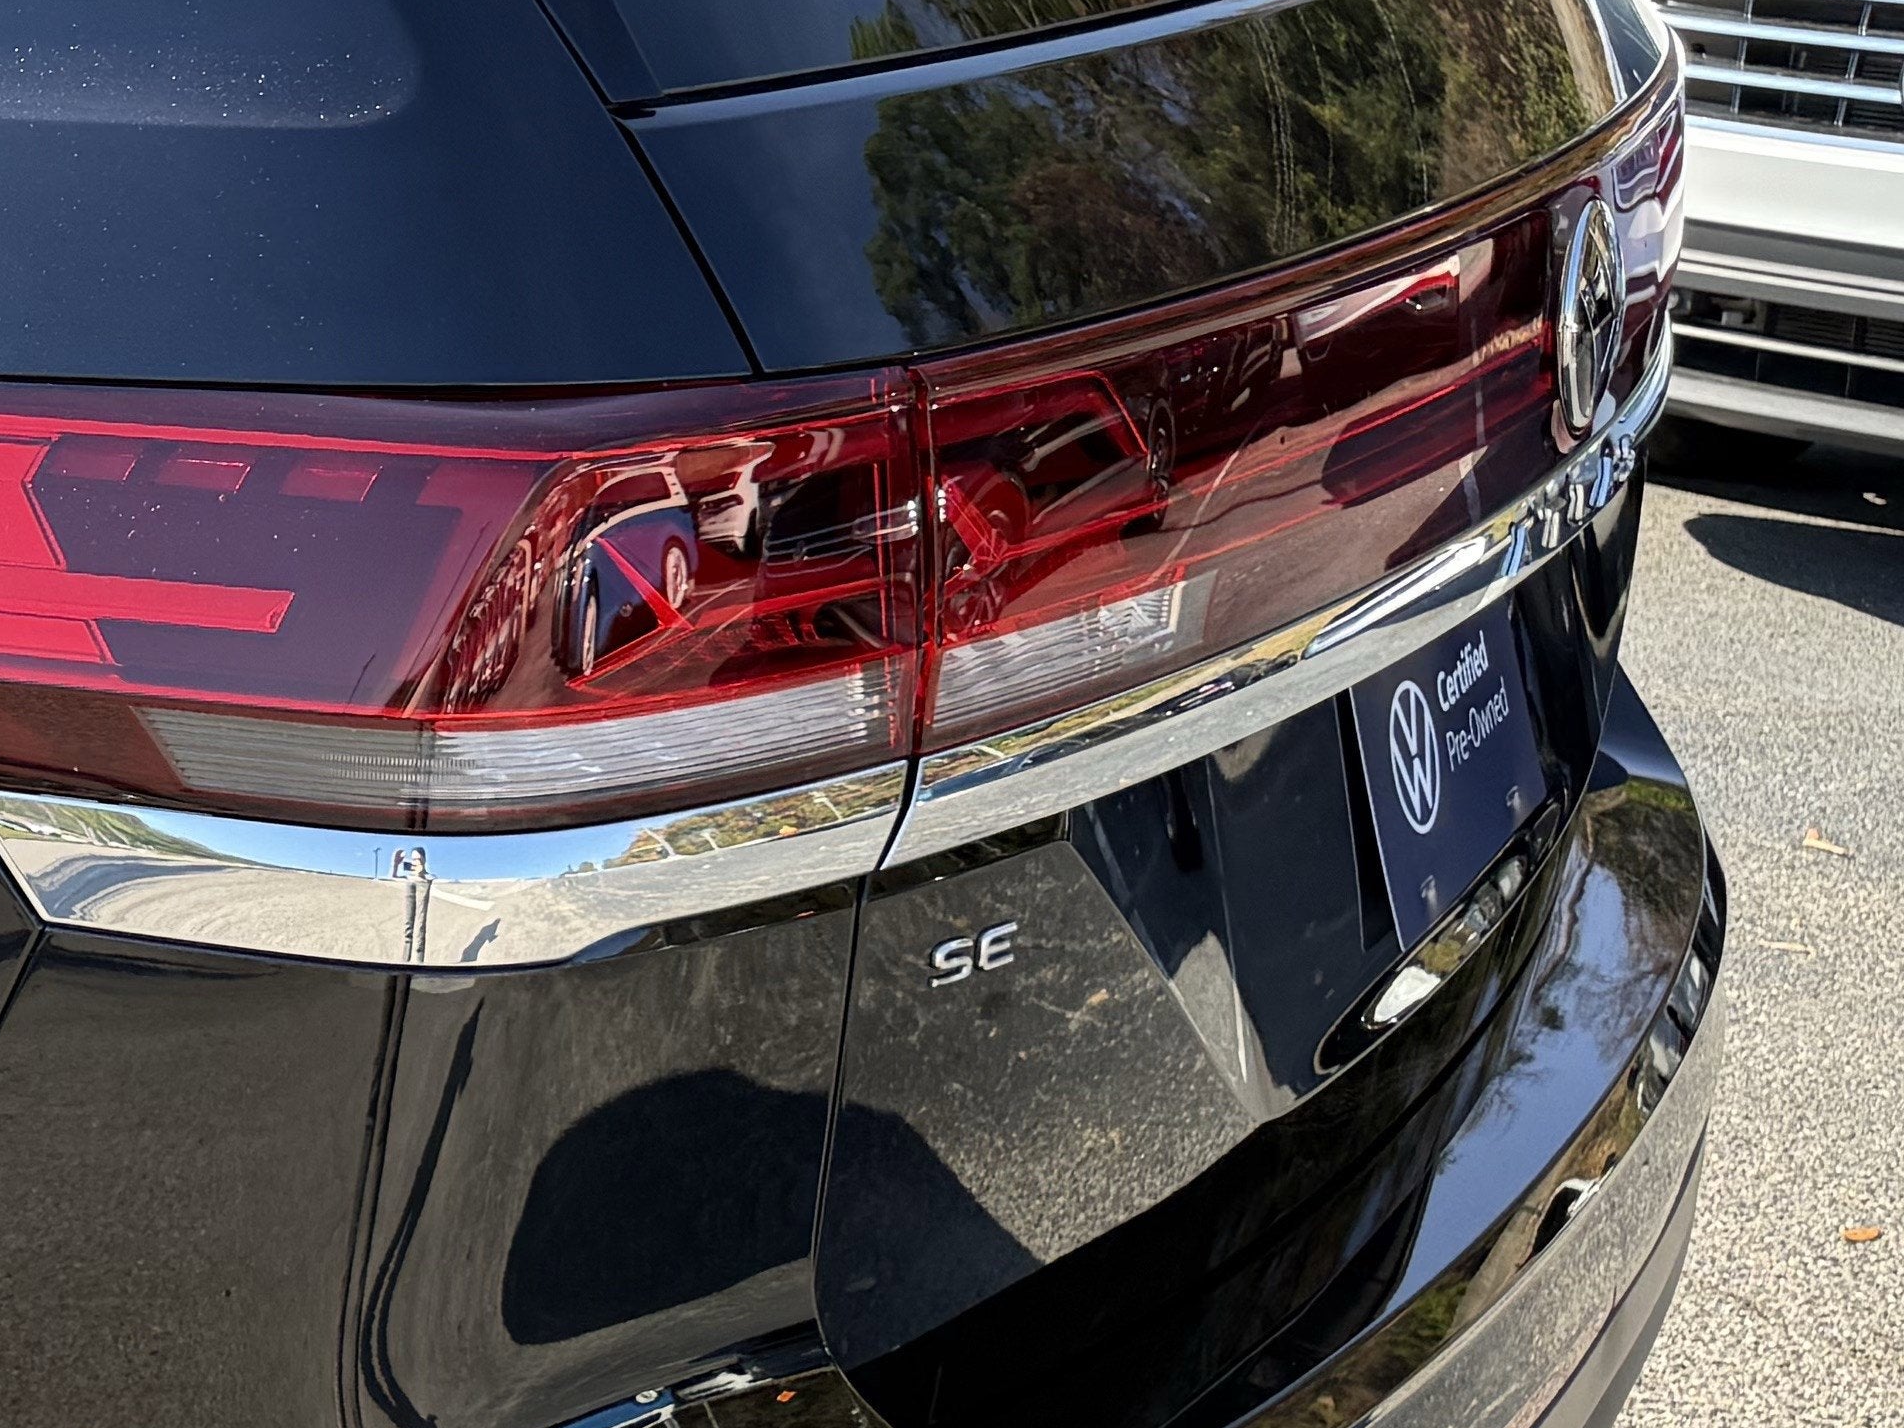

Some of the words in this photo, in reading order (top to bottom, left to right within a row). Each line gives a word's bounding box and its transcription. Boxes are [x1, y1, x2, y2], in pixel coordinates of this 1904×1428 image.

[1437, 629, 1489, 712] Certified
[1445, 675, 1510, 772] Pre-Owned
[929, 920, 1019, 988] SE
